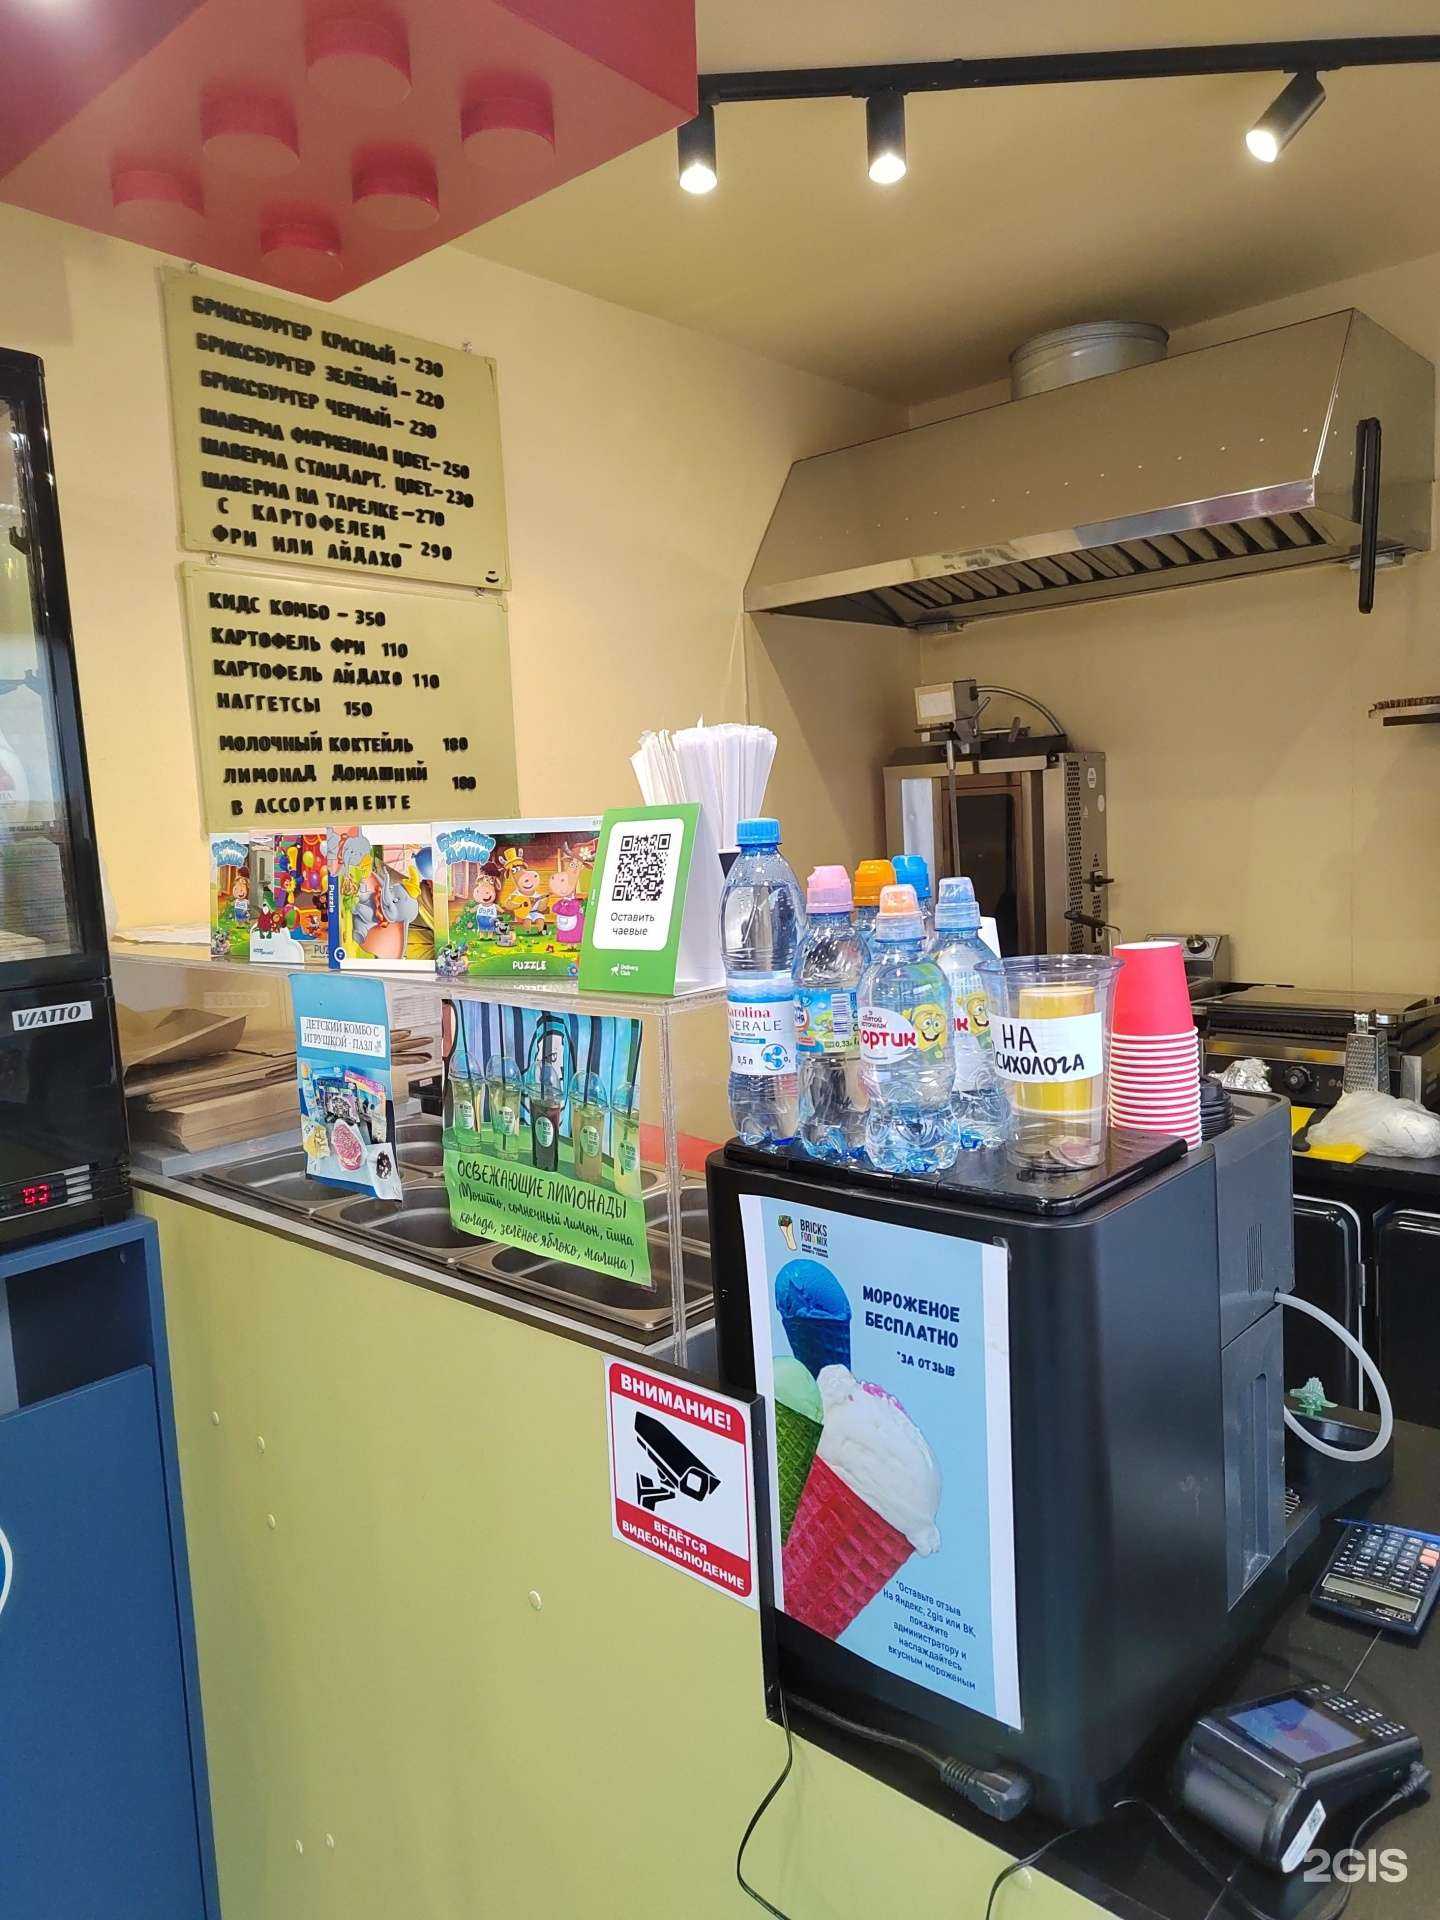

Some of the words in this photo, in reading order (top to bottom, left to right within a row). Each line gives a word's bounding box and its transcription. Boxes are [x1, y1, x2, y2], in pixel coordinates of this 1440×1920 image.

[192, 296, 312, 342] БРИКСБУРГЕР
[321, 330, 396, 365] КРАСНЫЙ
[415, 357, 444, 378] 230
[196, 332, 316, 378] БРИКСБУРГЕР
[325, 366, 398, 398] ЗЕЛЁНЫЙ
[416, 390, 445, 410] 220
[200, 369, 319, 410] БРИКСБУРГЕР
[325, 398, 391, 429] ЧЕРНЫЙ
[409, 420, 437, 439] 230
[200, 407, 284, 441] ШАВЕРМА
[291, 426, 388, 462] ФИРМЕННАЯ
[200, 437, 288, 470] ШАВЕРМА
[295, 456, 386, 490] СТАНДАРТ.
[201, 471, 290, 501] ШАВЕРМА
[296, 487, 319, 505] НА
[326, 493, 400, 521] ТАРЕЛКЕ
[415, 509, 445, 527] 270
[217, 496, 230, 514] С
[252, 503, 386, 540] КАРТОФЕЛЕМ
[212, 524, 257, 547] ФРИ
[272, 536, 313, 556] ИЛИ
[327, 540, 402, 569] АЙДАХО
[420, 541, 453, 561] 290
[208, 591, 261, 614] КИДС
[269, 598, 330, 621] КОМБО
[355, 609, 386, 627] 350
[211, 626, 321, 652] КАРТОФЕЛЬ
[330, 637, 366, 655] ФРИ
[383, 642, 409, 659] 110
[213, 658, 323, 683] КАРТОФЕЛЬ
[333, 662, 403, 687] АЙДАХО
[413, 672, 440, 689] 110
[216, 692, 321, 714] НАГГЕТСЫ
[343, 700, 373, 718] 150
[219, 730, 323, 753] МОЛОЧНЫЙ
[328, 731, 414, 753] КОКТЕЙЛЬ
[223, 764, 317, 785] ЛИМОНАД
[331, 760, 428, 783] ДОМАШНИЙ
[230, 799, 243, 816] В
[254, 794, 411, 815] АССОРТИМЕНТЕ
[611, 912, 655, 923] Оставить
[612, 927, 648, 936] чаевые
[512, 960, 547, 971] PUZZLE
[17, 1005, 81, 1027] VIATTO
[305, 1018, 343, 1033] ДЕТСКИЙ
[344, 1023, 373, 1037] КОМБО
[304, 1033, 347, 1049] ИГРУШКОЙ
[352, 1038, 373, 1051] ПАЗЛ
[1002, 1024, 1037, 1053] НА
[457, 1160, 545, 1198] ОСВЕЖАЮЩИЕ
[548, 1182, 627, 1219] ЛИМОНАДЫ
[508, 1200, 561, 1226] солнечный
[562, 1215, 603, 1241] лимон,
[606, 1228, 635, 1246] пина
[800, 1219, 827, 1237] BRICKS
[460, 1212, 497, 1235] колада,
[500, 1223, 539, 1243] зелёное
[540, 1233, 581, 1260] яблоко,
[584, 1248, 634, 1277] малина)
[863, 1285, 960, 1323] МОРОЖЕНОЕ
[865, 1311, 959, 1348] БЕСПЛАТНО
[918, 1358, 956, 1377] ОТЗЫВ
[620, 1373, 732, 1431] ВНИМАНИЕ!
[622, 1519, 745, 1591] ВИДЕОНАБЛЮДЕНИЕ
[653, 1519, 708, 1555] ВЕДЁТСЯ
[883, 1588, 894, 1601] На
[894, 1594, 926, 1616] Яндекс,
[926, 1608, 944, 1623] 2gis
[945, 1617, 961, 1629] или
[936, 1599, 961, 1617] отзыв
[893, 1621, 960, 1658] администратору
[909, 1615, 949, 1638] покажите
[888, 1645, 923, 1667] вкусным
[925, 1662, 976, 1689] мороженым
[899, 1637, 962, 1671] наслаждайтесь
